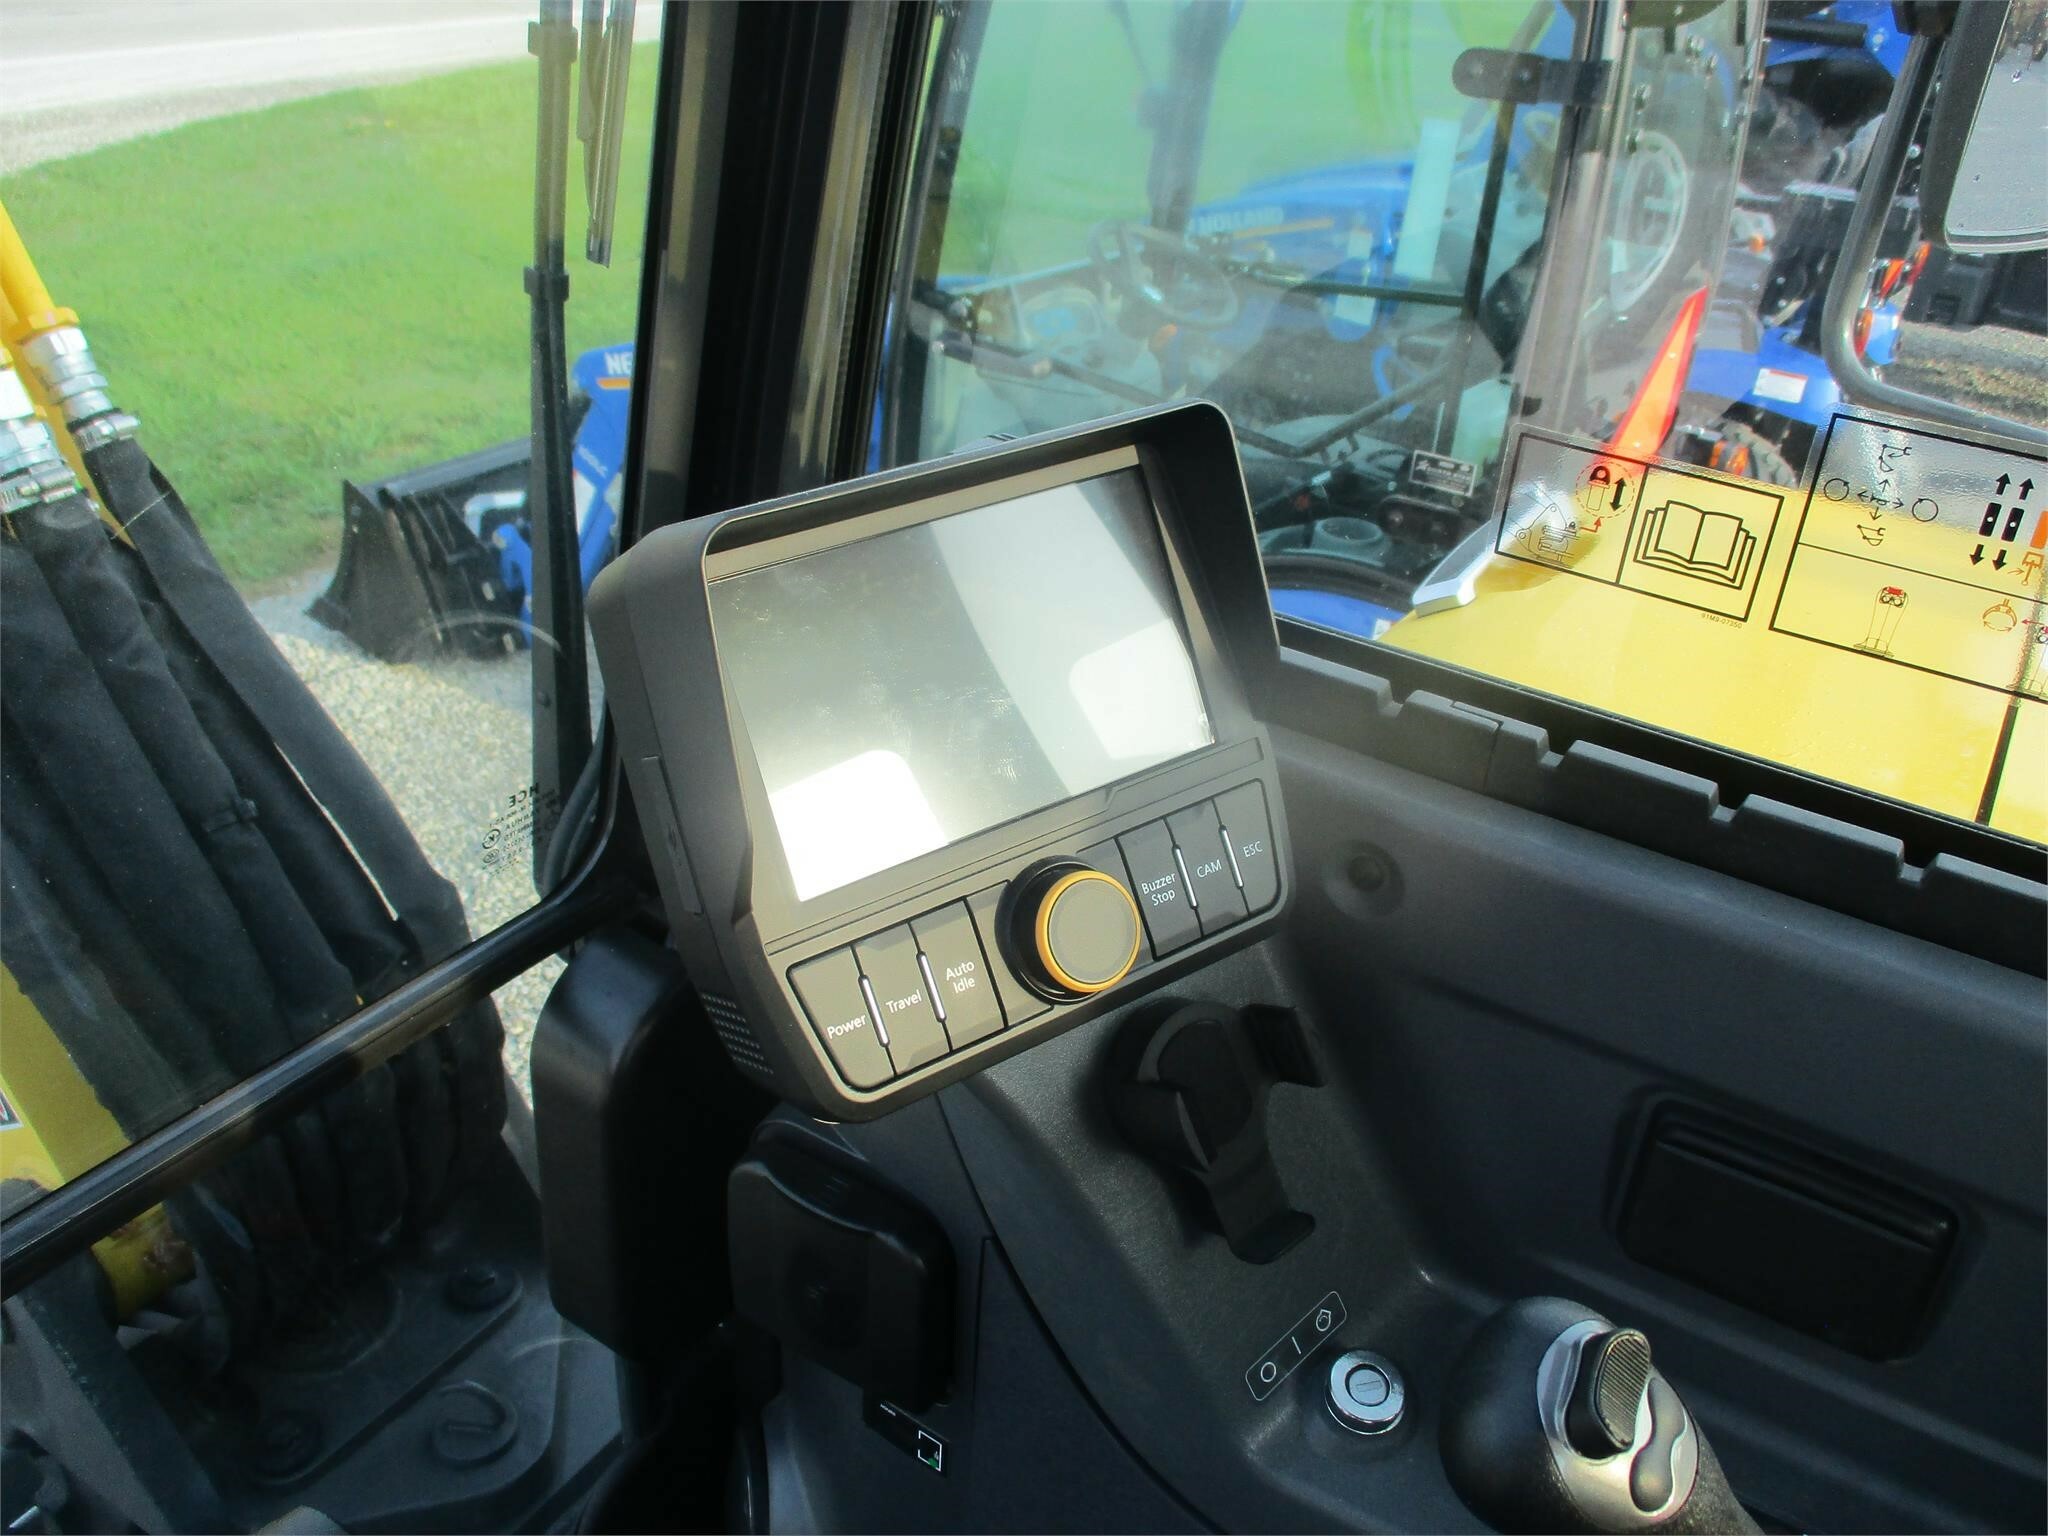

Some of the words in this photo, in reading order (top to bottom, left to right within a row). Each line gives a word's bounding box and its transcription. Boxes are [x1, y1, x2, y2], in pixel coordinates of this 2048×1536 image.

[1243, 841, 1263, 857] ESC
[1196, 859, 1222, 878] CAM
[1141, 873, 1176, 894] Buzzer
[1151, 889, 1176, 906] Stop
[945, 961, 975, 981] Auto
[952, 976, 976, 993] Idle
[885, 989, 922, 1014] Travel
[827, 1015, 866, 1039] Power
